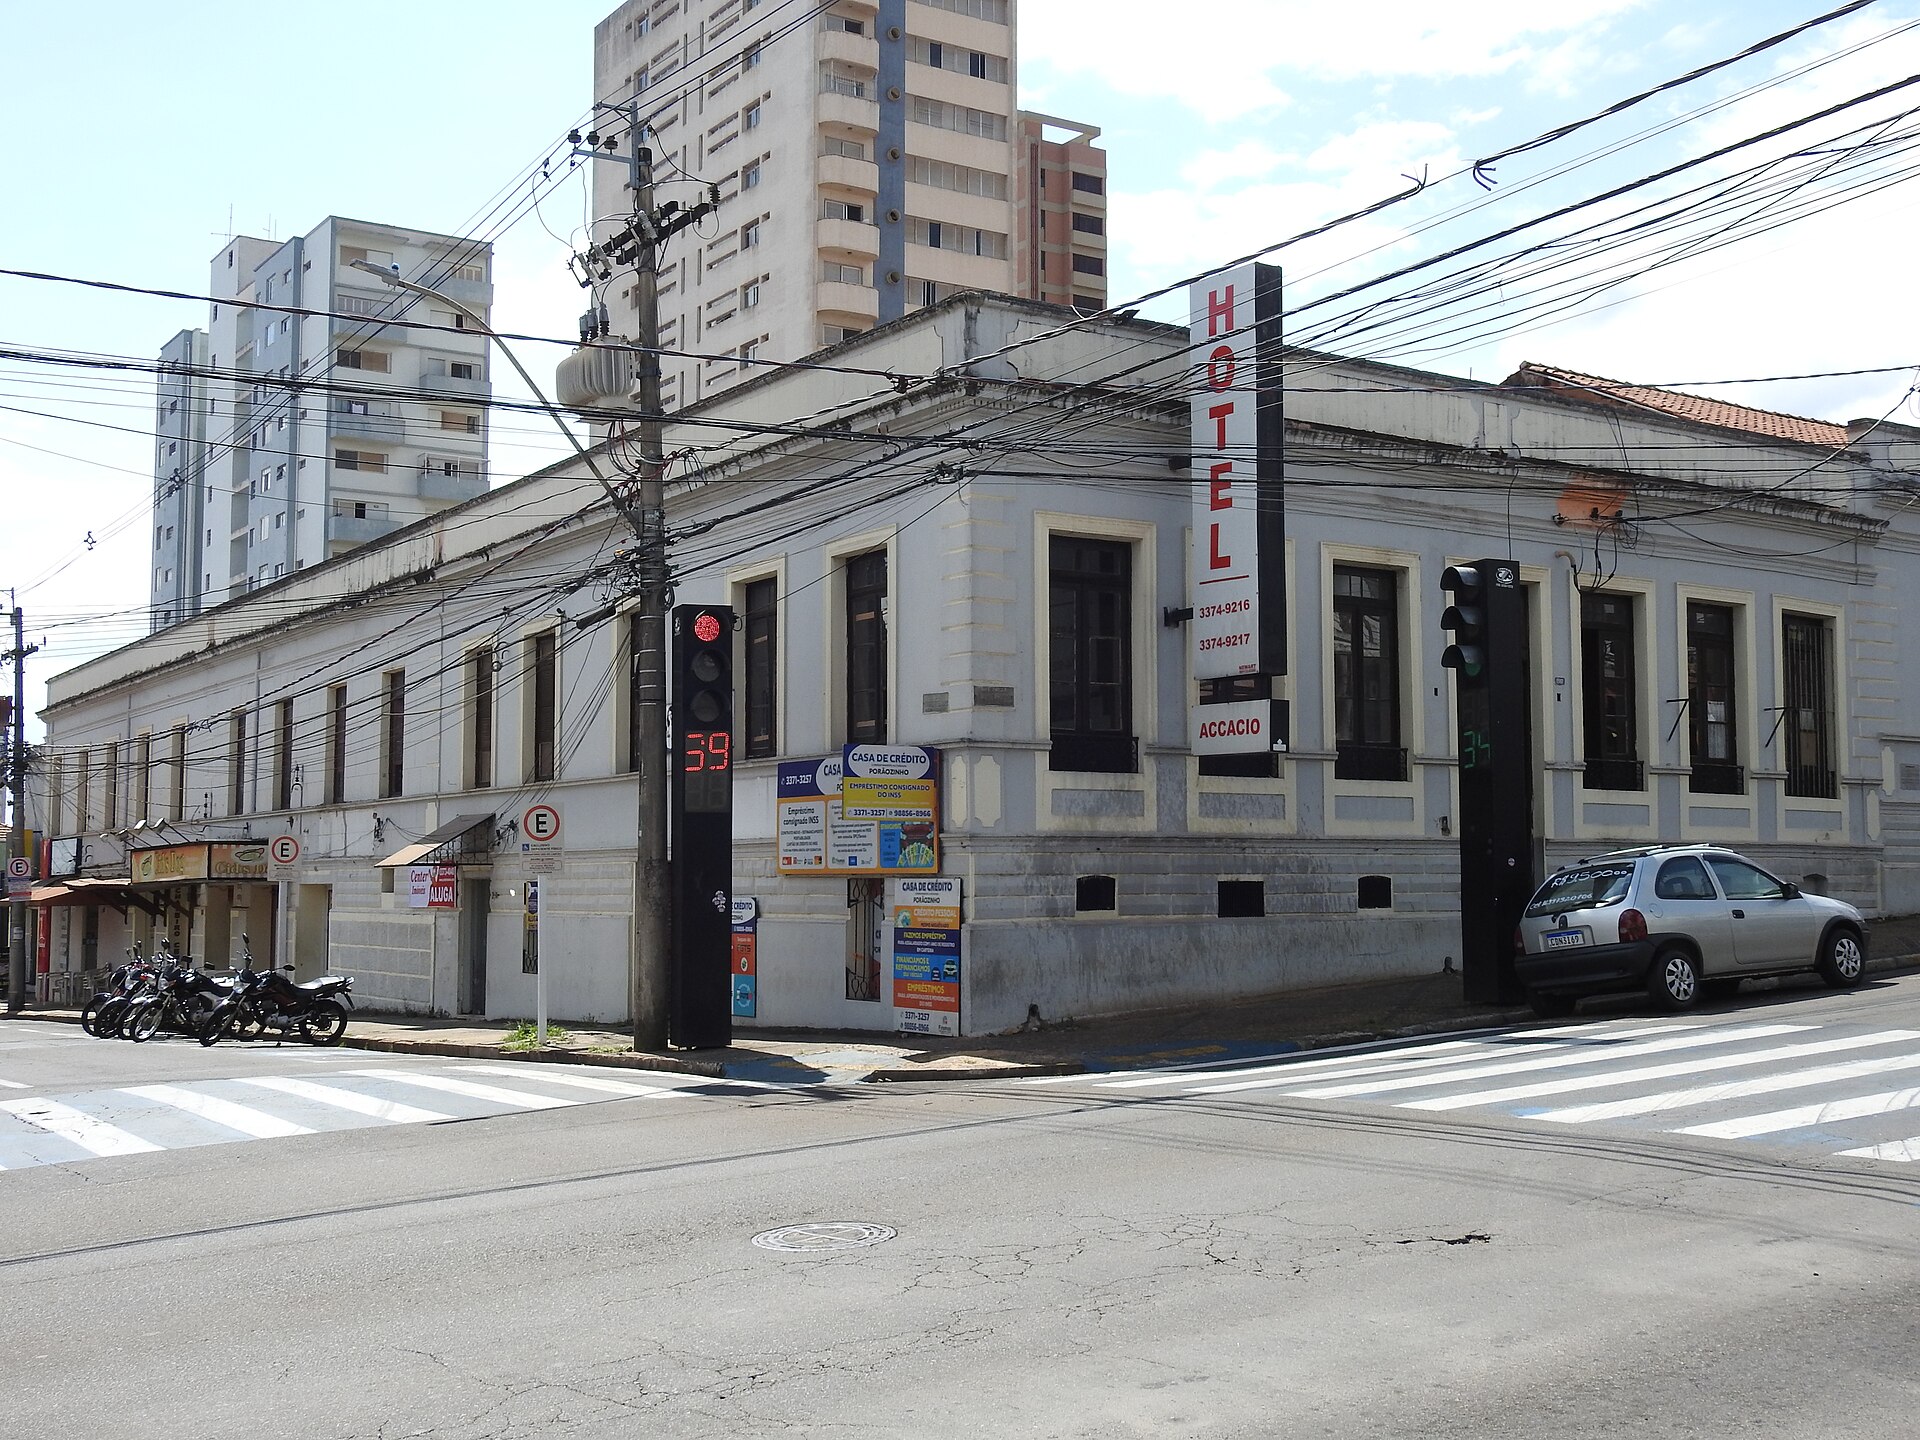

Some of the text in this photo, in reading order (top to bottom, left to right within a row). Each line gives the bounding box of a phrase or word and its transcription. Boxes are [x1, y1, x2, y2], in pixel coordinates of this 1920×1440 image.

[1208, 284, 1234, 570] HOTEL
[1199, 599, 1250, 619] 3374-9216
[1199, 633, 1250, 651] 3374-9217
[1199, 718, 1261, 739] ACCACIO
[685, 732, 729, 771] 59
[851, 752, 927, 764] CASA DE CRÉDITO
[823, 763, 842, 776] CASA
[869, 767, 909, 776] PORÃOZINHO
[785, 774, 812, 786] 3371-3257
[854, 809, 885, 817] 3371-3257
[535, 813, 548, 834] E
[281, 842, 290, 857] E
[15, 862, 23, 873] E
[902, 879, 953, 892] CASA DE CRÉDITO
[430, 886, 454, 902] ALUGA
[904, 1011, 930, 1021] 3371-3257
